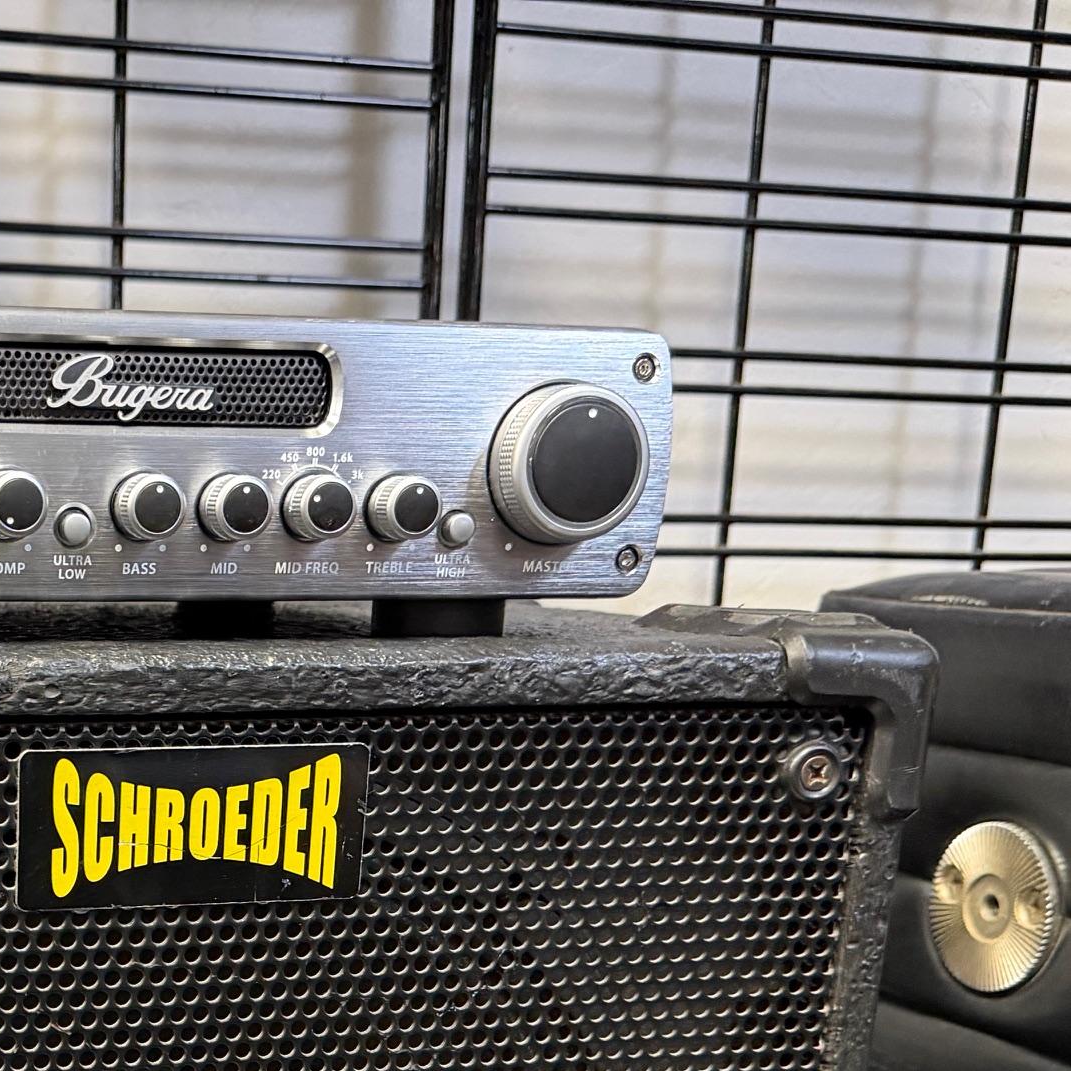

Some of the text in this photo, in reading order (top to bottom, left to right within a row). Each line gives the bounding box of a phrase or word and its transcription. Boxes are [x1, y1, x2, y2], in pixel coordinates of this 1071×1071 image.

[46, 354, 215, 421] Bugera
[280, 452, 300, 463] 450
[306, 447, 325, 457] 800
[332, 452, 353, 464] 1.6k
[262, 469, 280, 480] 220
[53, 555, 92, 566] ULTRA
[434, 553, 471, 565] ULTRA
[122, 562, 157, 575] BASS
[210, 562, 238, 574] MID
[274, 562, 340, 576] MID FREQ
[365, 561, 413, 574] TREBLE
[436, 566, 466, 578] HIGH
[58, 569, 86, 580] LOW
[51, 753, 342, 898] SCHROEDER
